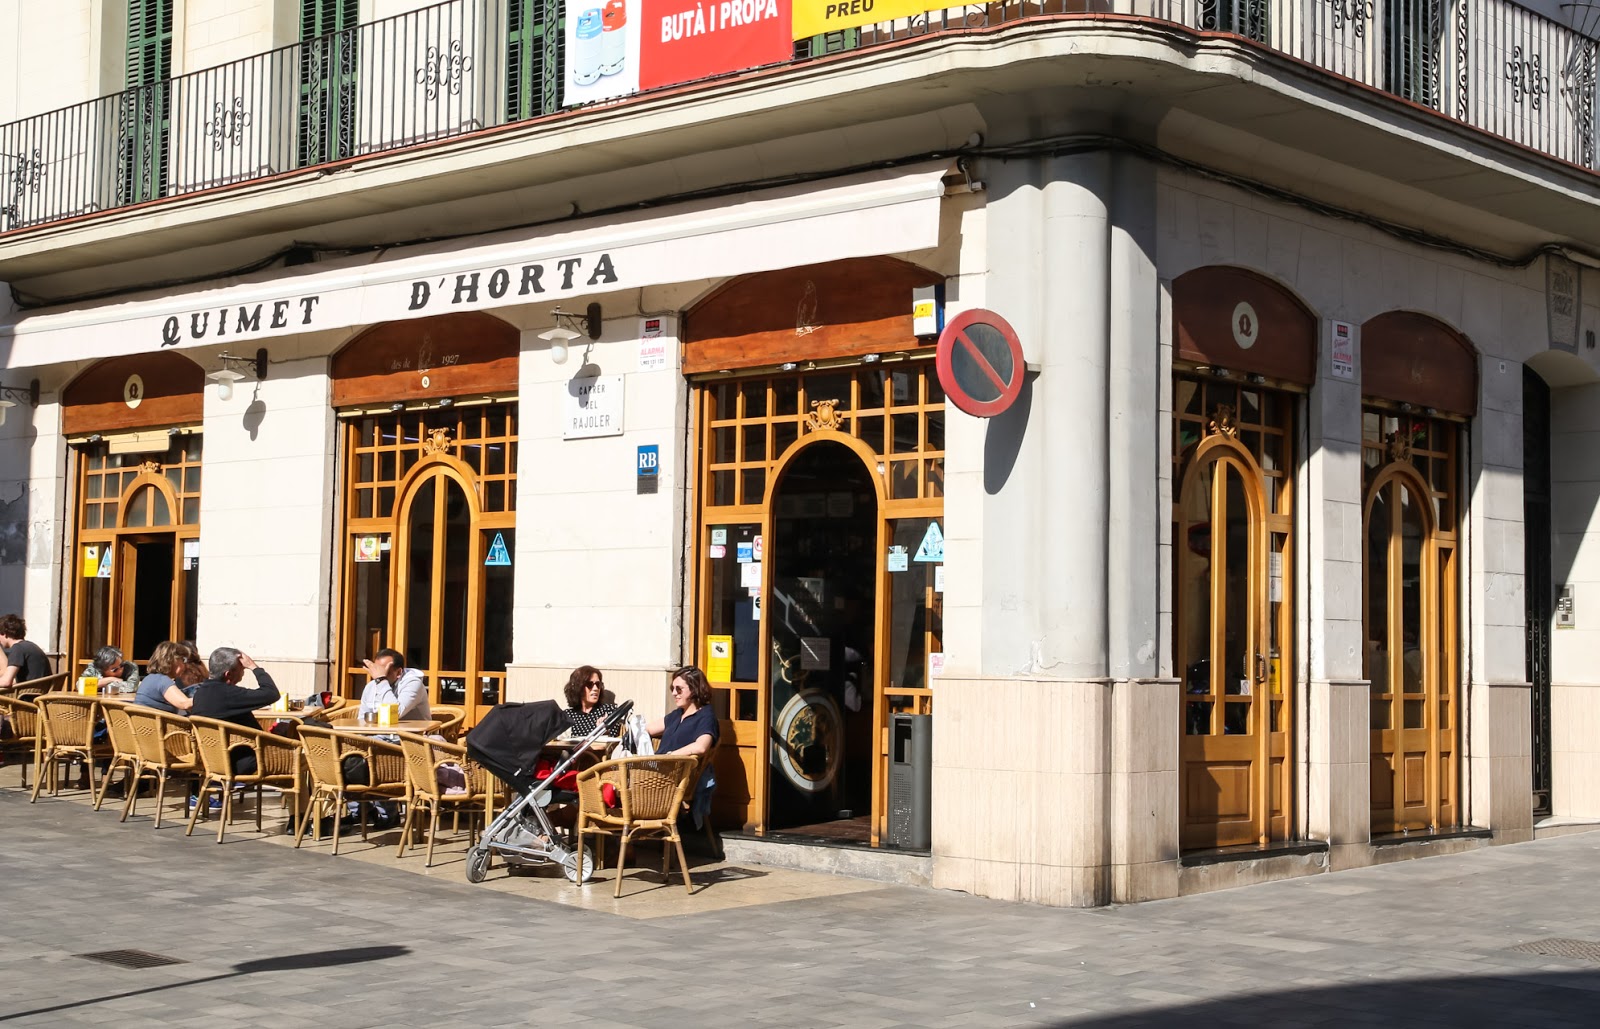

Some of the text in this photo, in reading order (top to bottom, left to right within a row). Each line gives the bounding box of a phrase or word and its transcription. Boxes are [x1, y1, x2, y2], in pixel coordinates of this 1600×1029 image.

[825, 0, 874, 19] PREU
[661, 2, 706, 43] BUTÀ
[710, 5, 715, 32] I
[160, 253, 619, 348] QUIMET D'HORTA
[1238, 312, 1252, 337] Q
[1586, 329, 1595, 350] 10
[441, 354, 460, 366] 1927
[129, 382, 139, 399] Q
[578, 384, 606, 396] CARRER
[585, 401, 598, 410] DEL
[573, 414, 611, 429] RAJOLER
[638, 452, 657, 469] RB
